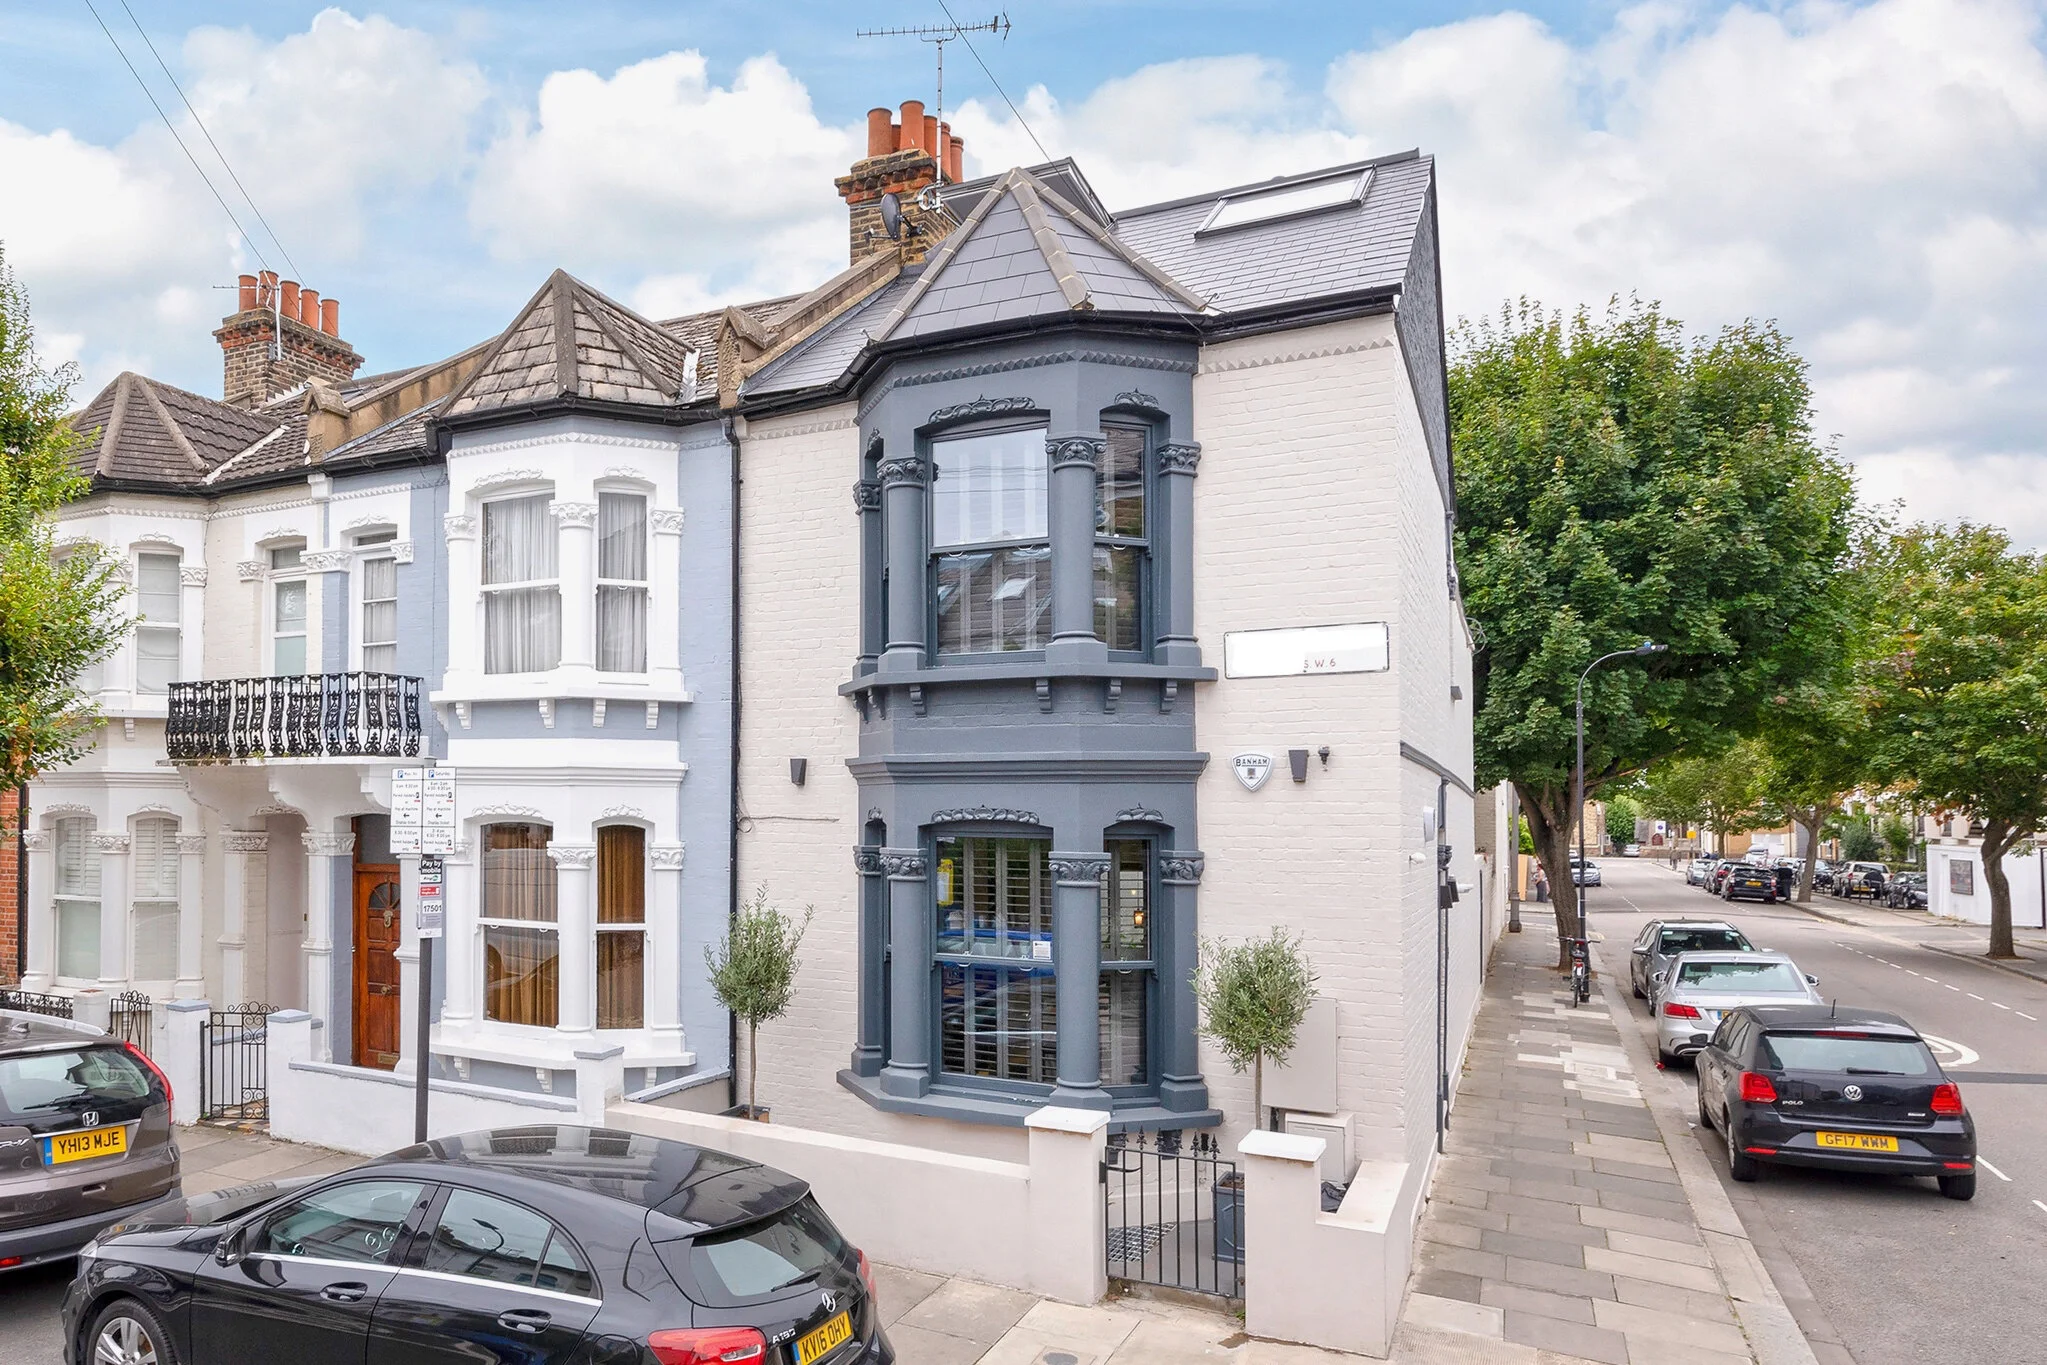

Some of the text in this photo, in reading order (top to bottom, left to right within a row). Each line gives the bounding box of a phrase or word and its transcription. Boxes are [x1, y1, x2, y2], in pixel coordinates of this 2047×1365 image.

[1235, 758, 1268, 767] BANHAM
[421, 859, 442, 868] Pay by
[423, 904, 442, 913] 17501
[58, 1131, 120, 1155] YH13 MJE
[1825, 1133, 1857, 1147] GF17
[802, 1315, 848, 1363] KV16 OHY
